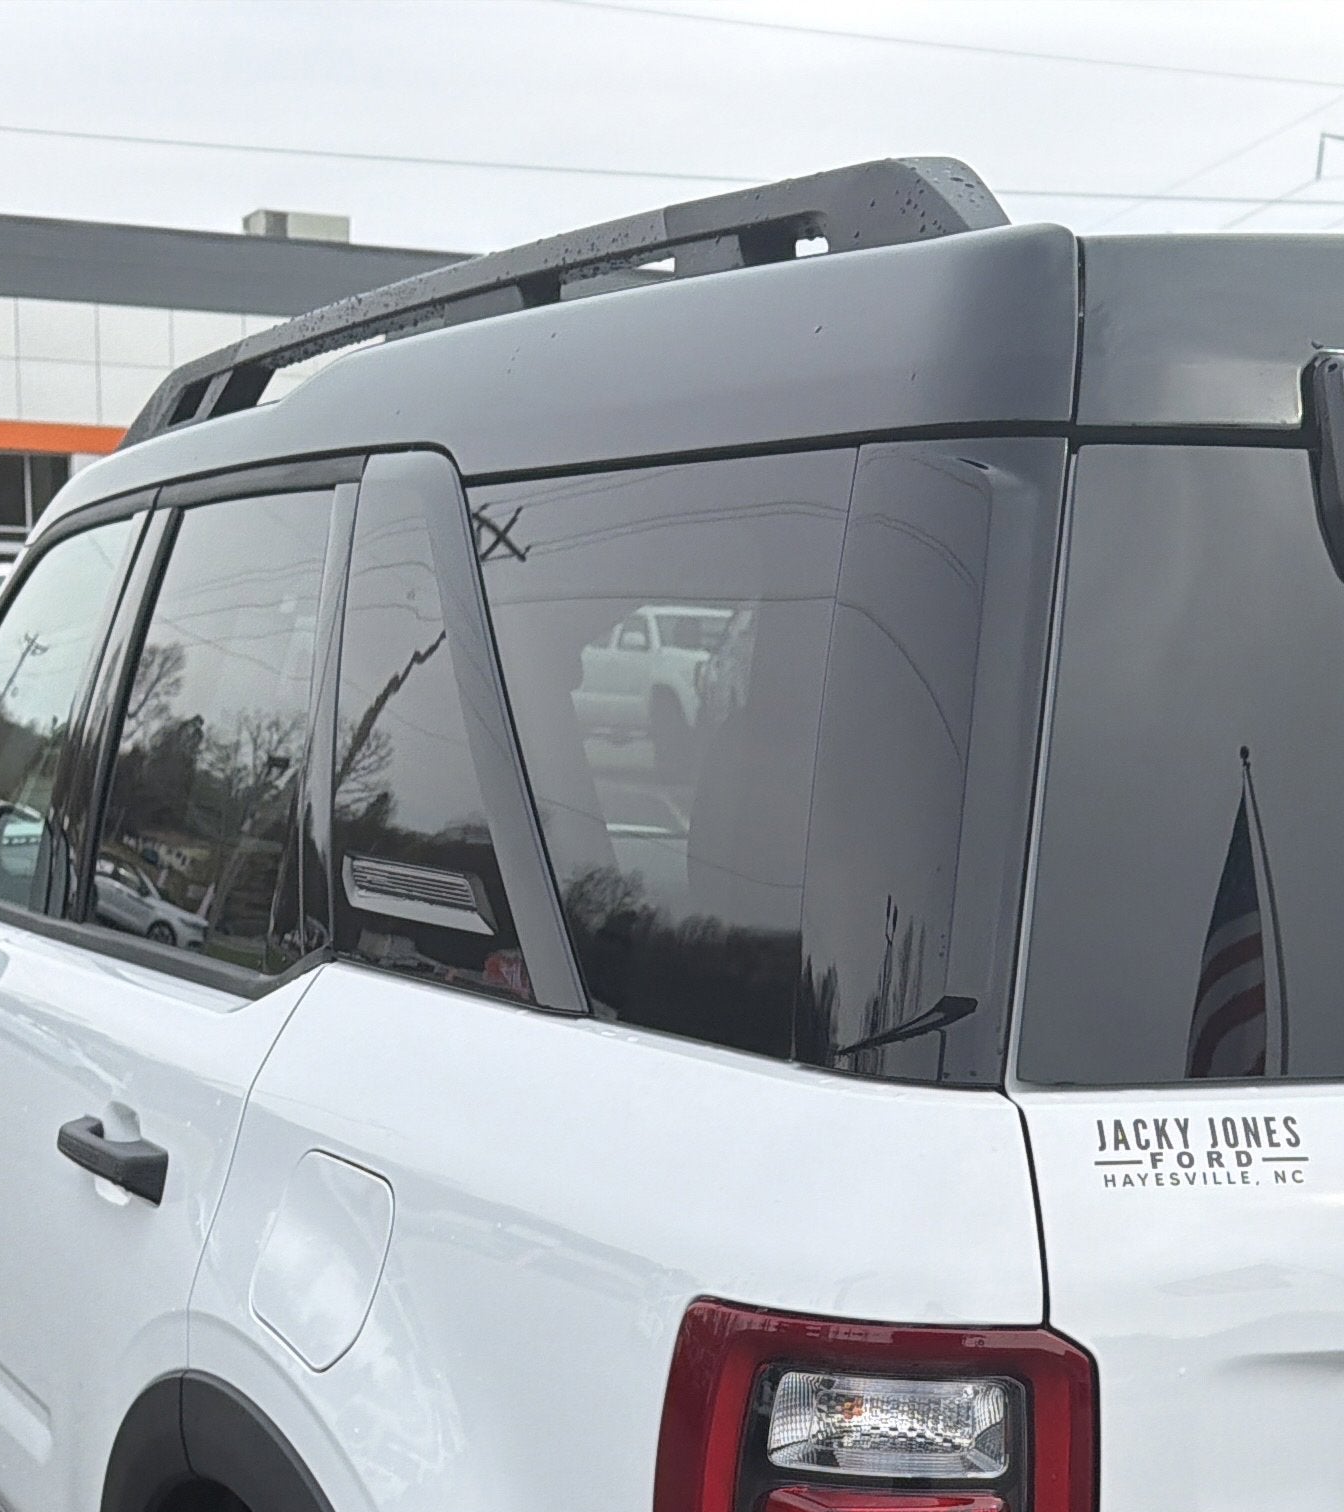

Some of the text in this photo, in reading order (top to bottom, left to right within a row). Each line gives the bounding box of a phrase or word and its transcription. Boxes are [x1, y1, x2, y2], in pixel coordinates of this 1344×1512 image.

[1096, 1116, 1301, 1151] JACKY JONES
[1150, 1151, 1253, 1169] FORD
[1103, 1169, 1305, 1188] HAYESVILLE, NC
